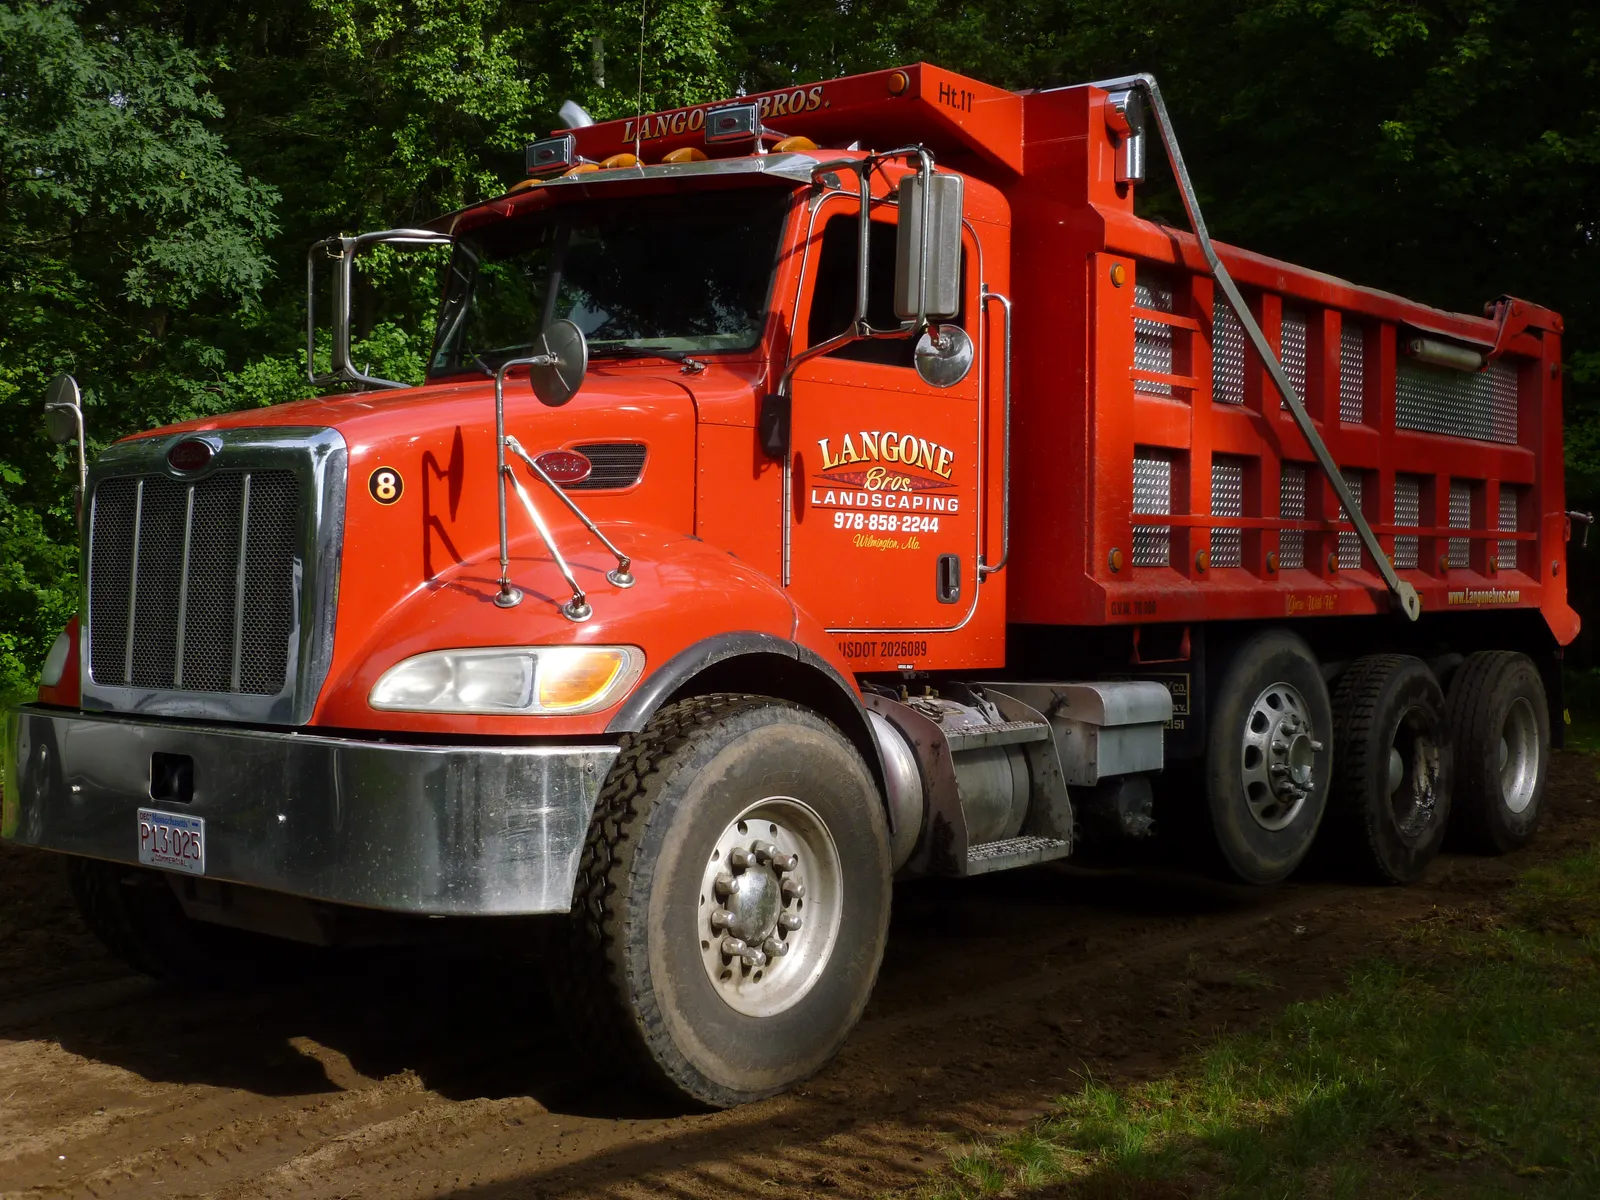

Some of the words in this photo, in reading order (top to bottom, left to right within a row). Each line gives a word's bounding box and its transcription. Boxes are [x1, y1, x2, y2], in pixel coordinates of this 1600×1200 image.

[622, 102, 739, 143] LANGO
[757, 86, 831, 119] BROS.
[817, 431, 955, 480] LANGONE
[377, 473, 396, 499] 8
[863, 466, 913, 492] Bros.
[811, 490, 959, 512] LANDSCAPING
[833, 512, 939, 533] 978-858-2244
[1448, 587, 1520, 607] www.Langonebros.com
[880, 641, 927, 657] 2026089
